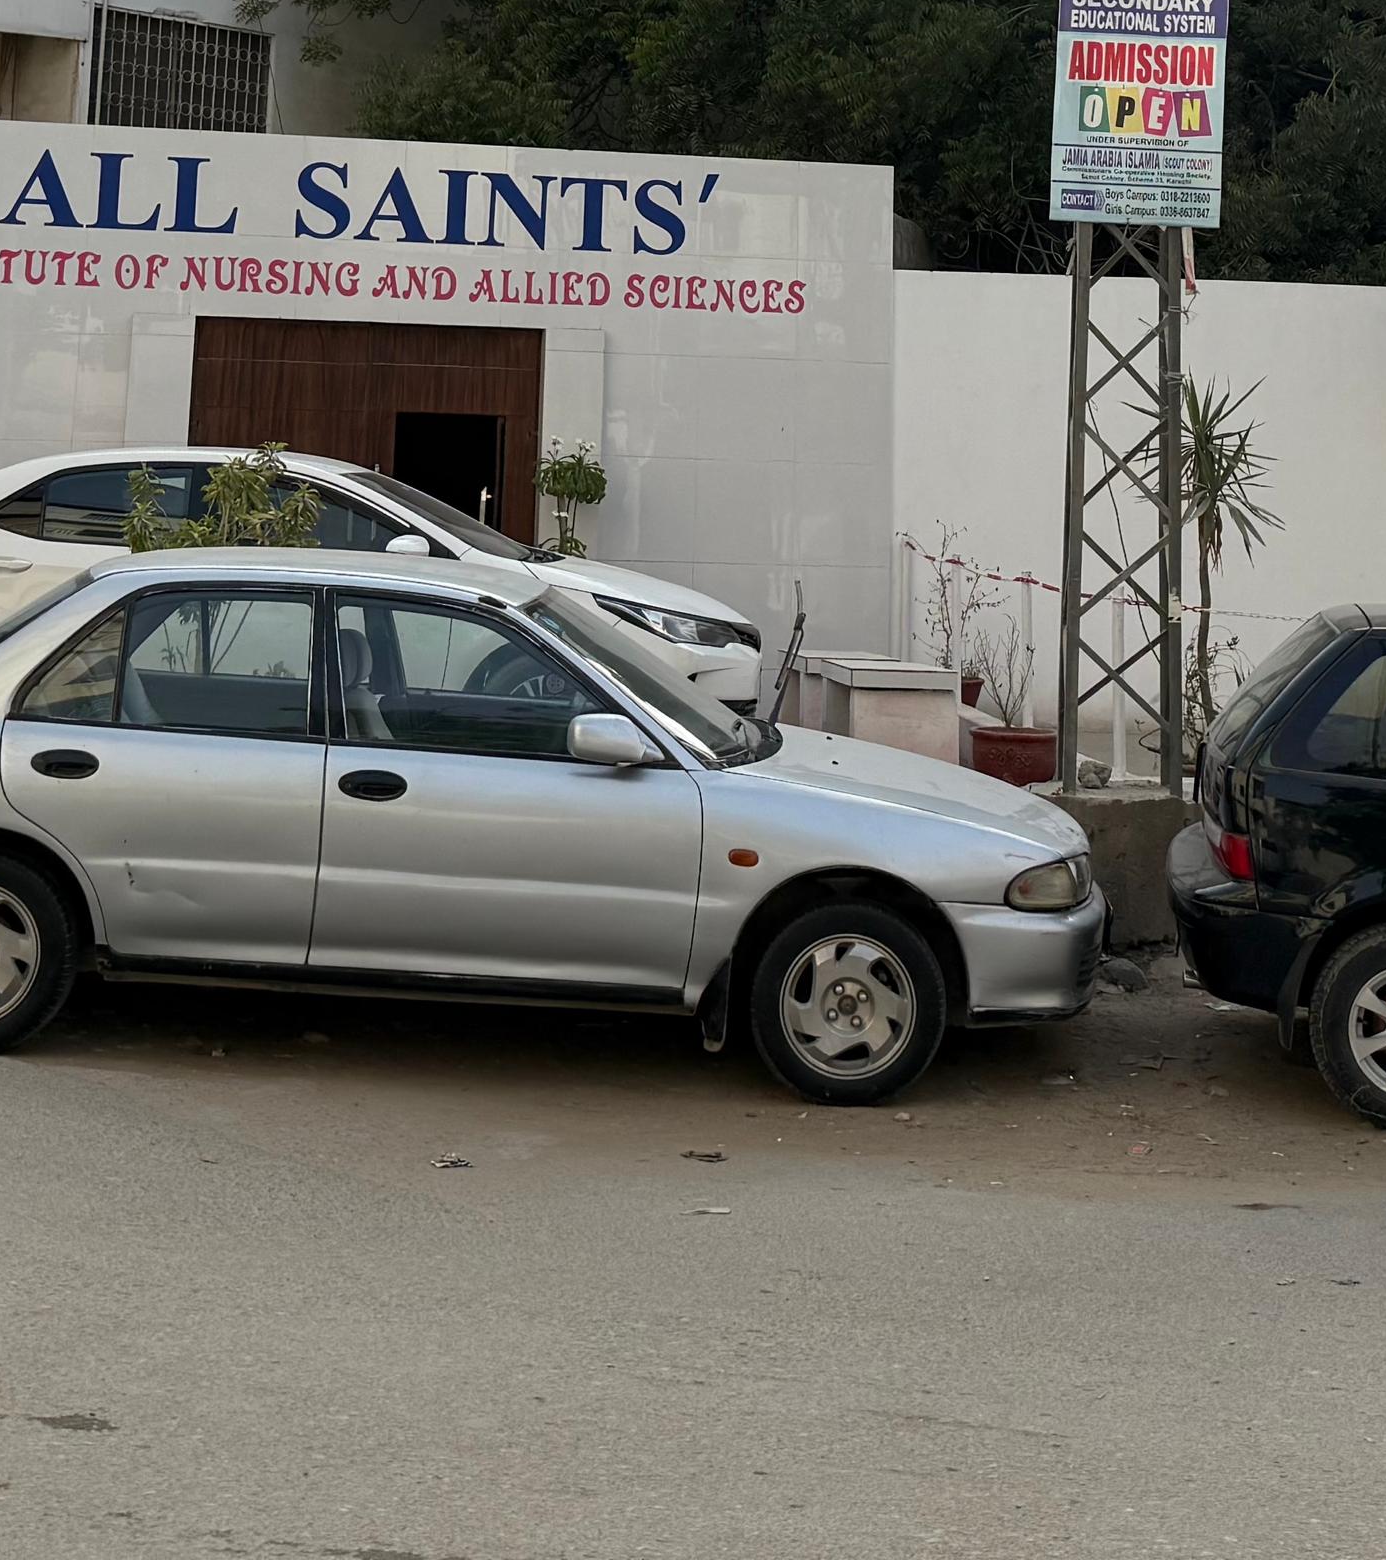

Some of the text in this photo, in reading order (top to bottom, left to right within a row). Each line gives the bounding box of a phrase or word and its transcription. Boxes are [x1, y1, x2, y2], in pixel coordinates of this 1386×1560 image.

[1070, 10, 1216, 34] EDUCATIONAL SYSTEM
[1068, 40, 1215, 86] ADMISSION
[1083, 94, 1201, 131] OPEN
[1086, 136, 1115, 144] UNDER
[1118, 137, 1175, 147] SUPERVISION
[1062, 149, 1088, 166] JAMIA
[1090, 150, 1123, 168] ARABIA
[1125, 152, 1160, 170] ISLAMIA
[1062, 193, 1094, 206] CONTACT
[1105, 188, 1124, 201] Boys
[1126, 189, 1159, 202] Campus:
[293, 161, 720, 256] SAINTS'
[1104, 204, 1123, 215] Girls
[1124, 204, 1158, 218] Campus:
[115, 251, 165, 291] OF
[183, 256, 362, 300] NURSING
[371, 263, 457, 303] AND
[468, 268, 611, 309] ALLIED
[622, 273, 808, 316] SCIENCES
